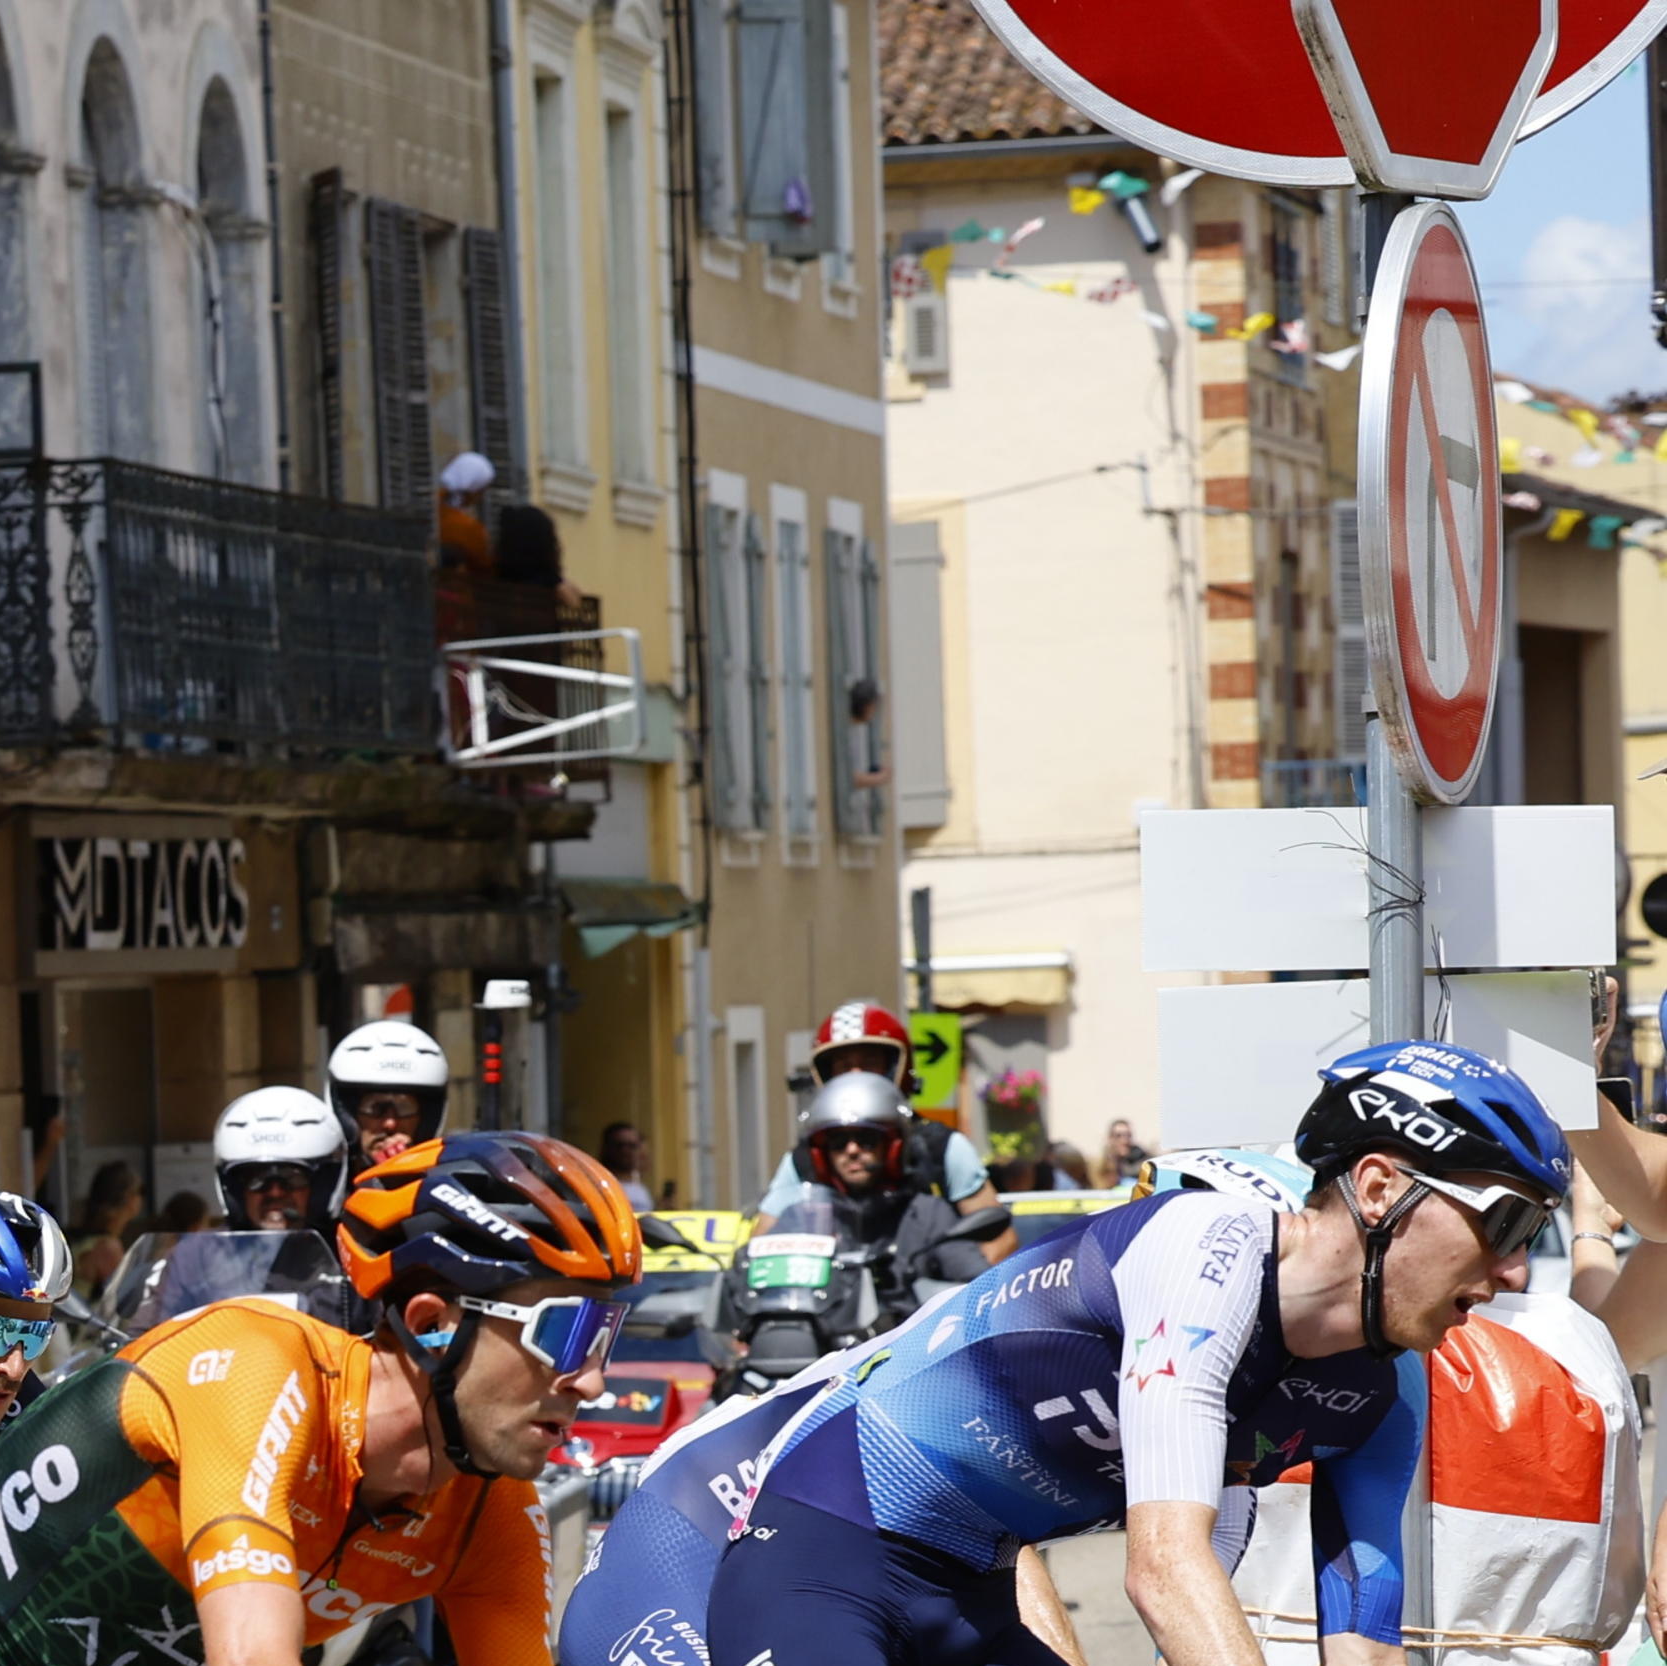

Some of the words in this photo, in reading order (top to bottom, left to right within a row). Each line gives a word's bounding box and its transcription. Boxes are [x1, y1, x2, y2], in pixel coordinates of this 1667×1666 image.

[1403, 1044, 1465, 1070] ISRAEL
[1407, 1065, 1435, 1080] TECH
[430, 1183, 531, 1242] GIANT
[973, 1256, 1072, 1318] FACTOR
[241, 1369, 309, 1517] GIANT
[191, 1546, 294, 1588] letsgo
